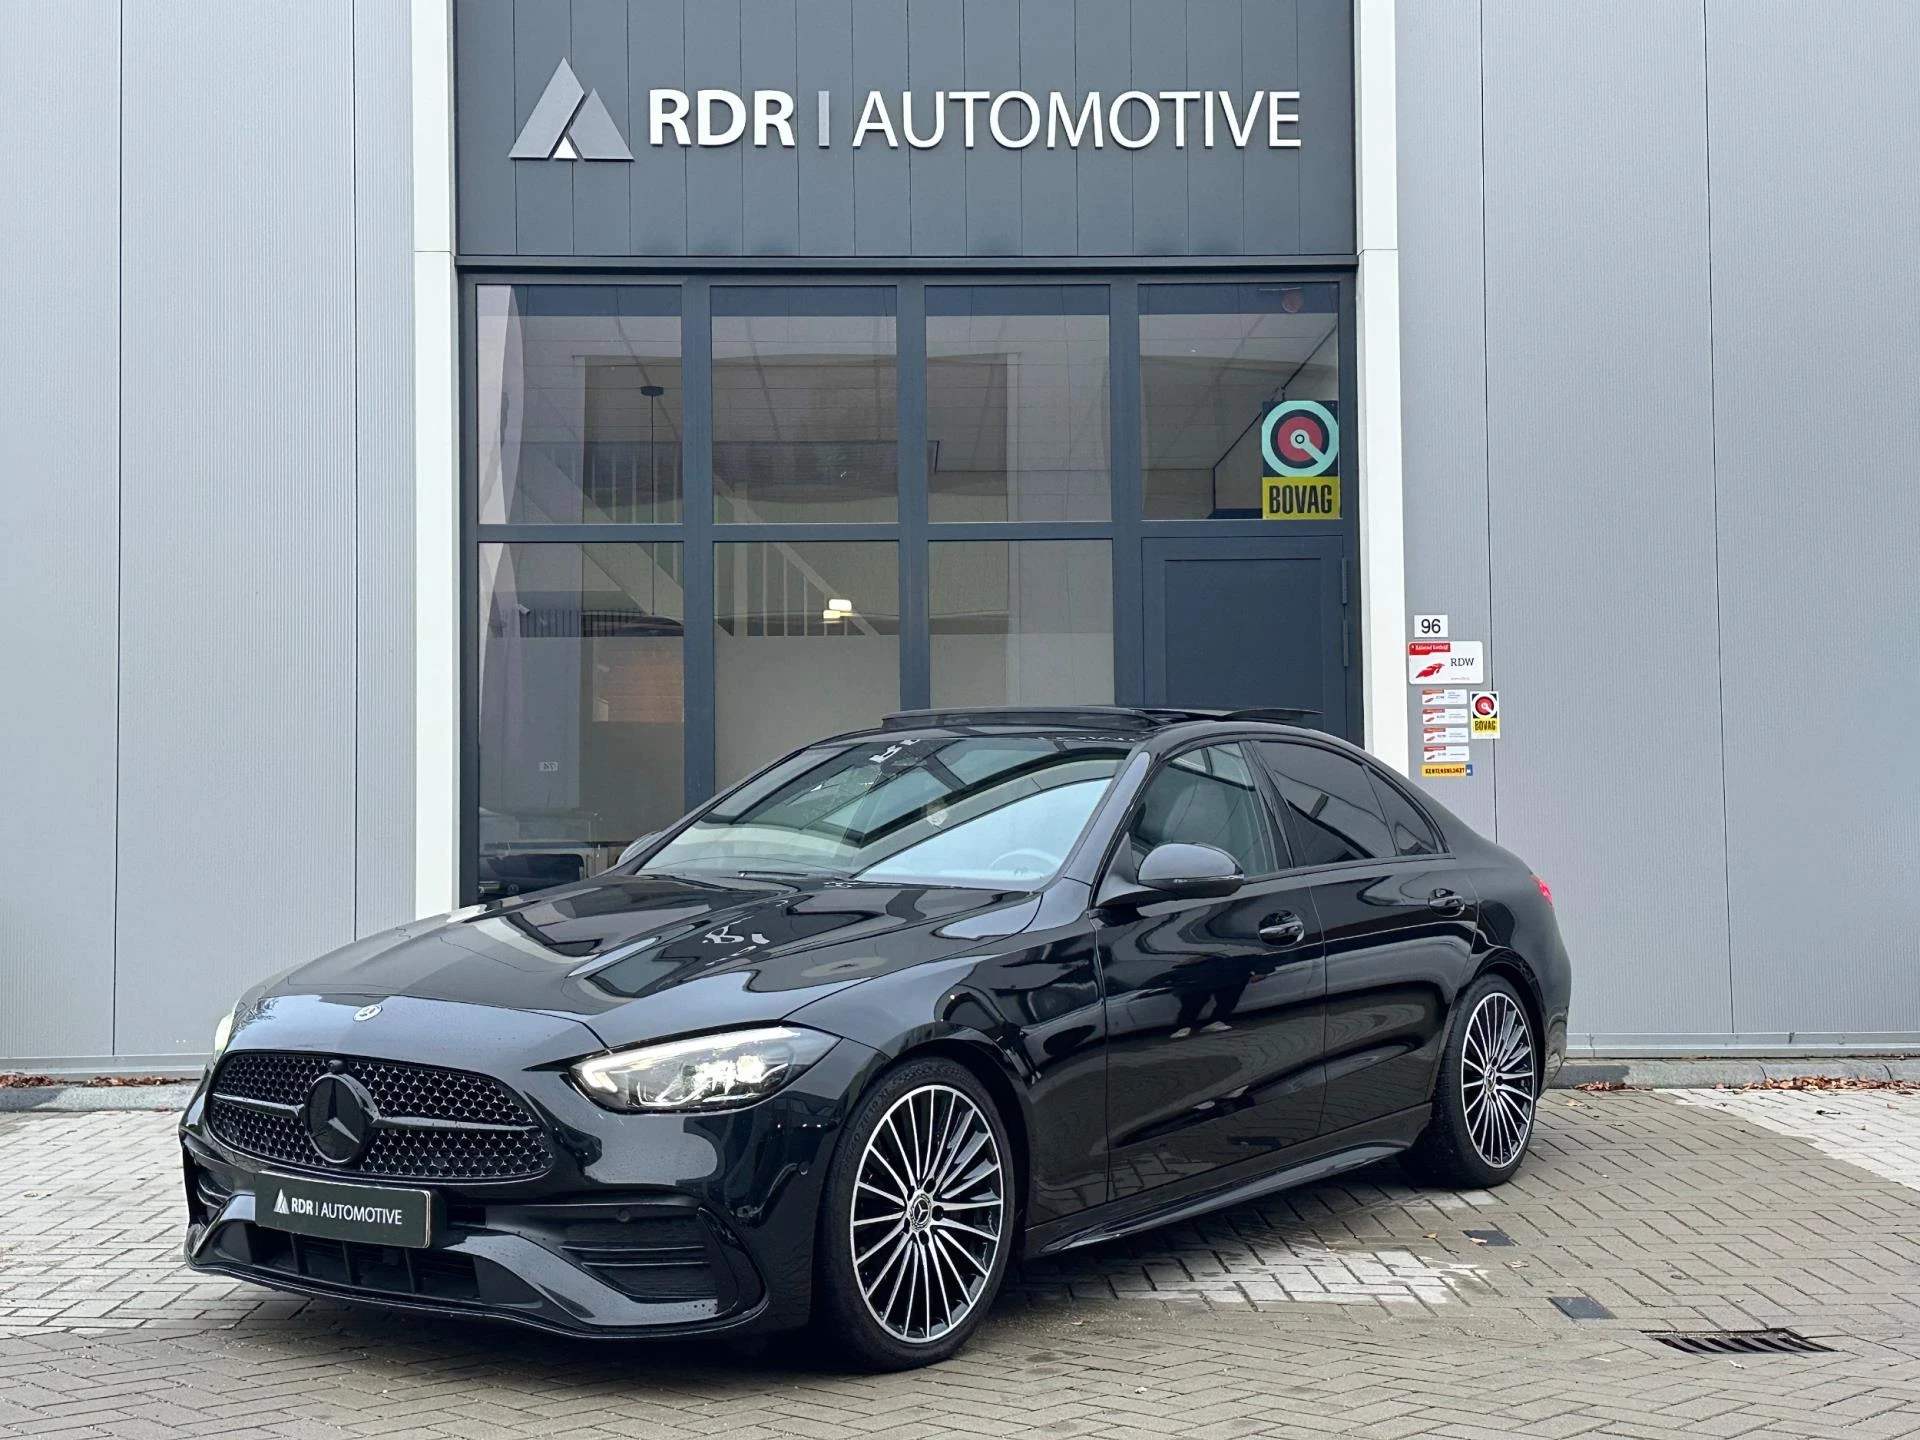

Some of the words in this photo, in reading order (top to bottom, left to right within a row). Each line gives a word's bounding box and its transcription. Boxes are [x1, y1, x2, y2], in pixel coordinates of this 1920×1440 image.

[648, 88, 797, 147] RDR
[852, 90, 1302, 149] AUTOMOTIVE
[1269, 484, 1333, 514] BOVAG
[1421, 618, 1441, 634] 96
[1450, 657, 1475, 667] RDW
[1474, 720, 1497, 731] BOVAG
[291, 1197, 313, 1216] RDR
[320, 1202, 403, 1225] AUTOMOTIVE
